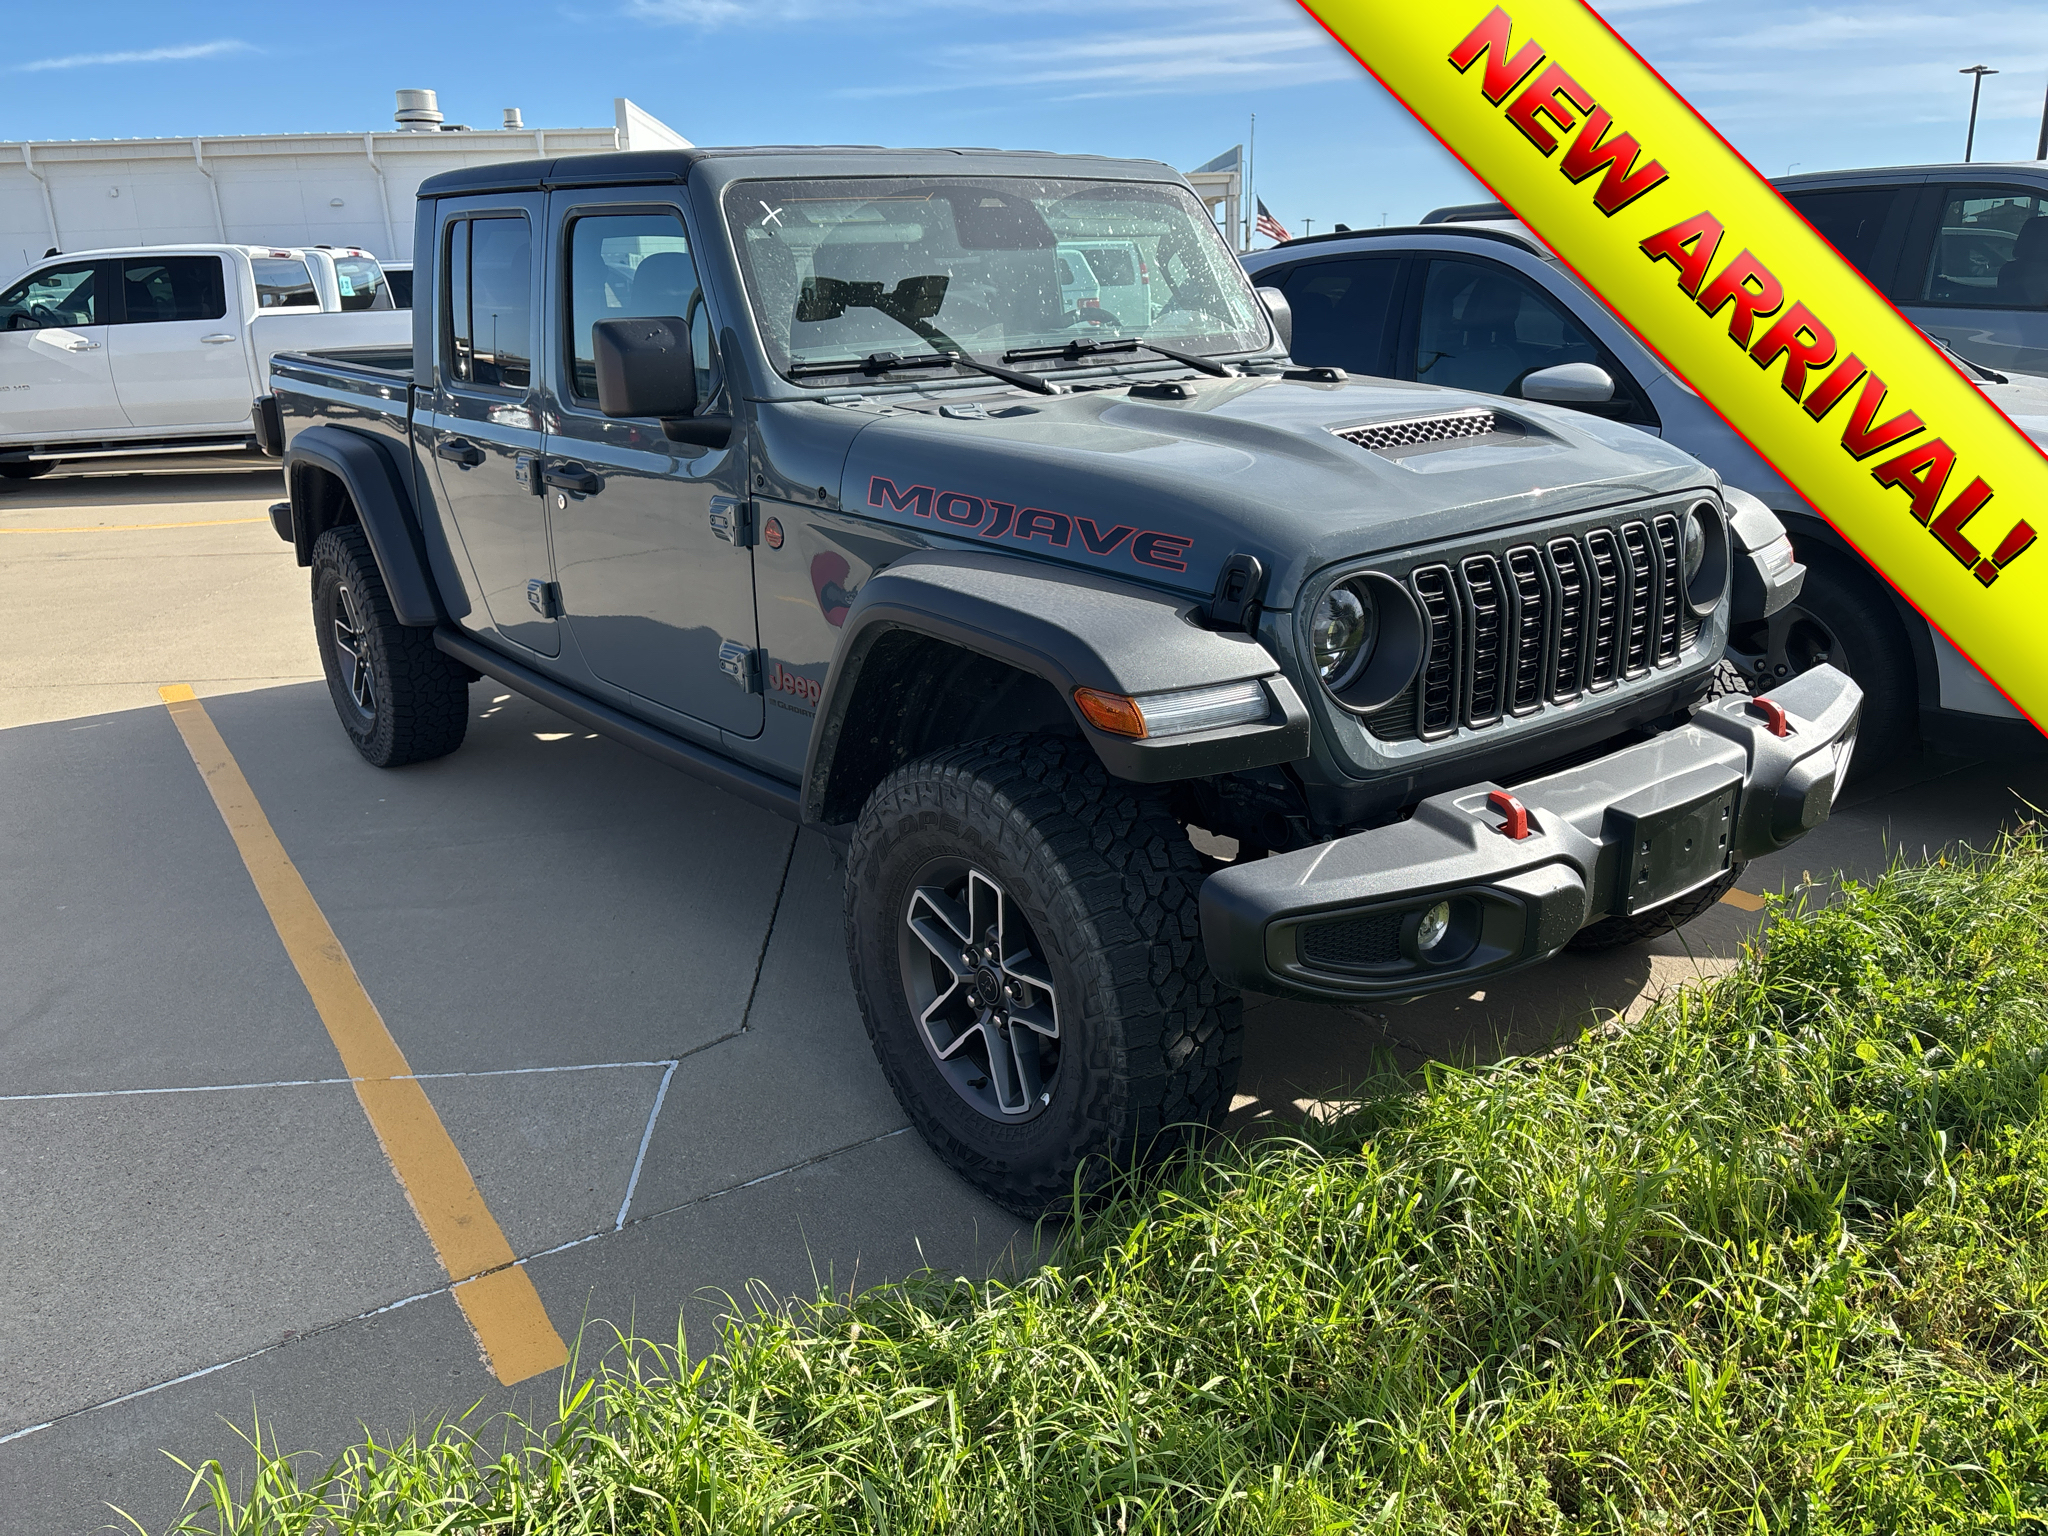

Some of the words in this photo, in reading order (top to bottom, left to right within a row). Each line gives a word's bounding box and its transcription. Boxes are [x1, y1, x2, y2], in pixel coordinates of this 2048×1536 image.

[867, 475, 1194, 573] MOJAVE
[768, 662, 822, 708] Jeep
[776, 700, 816, 719] GLADIATO
